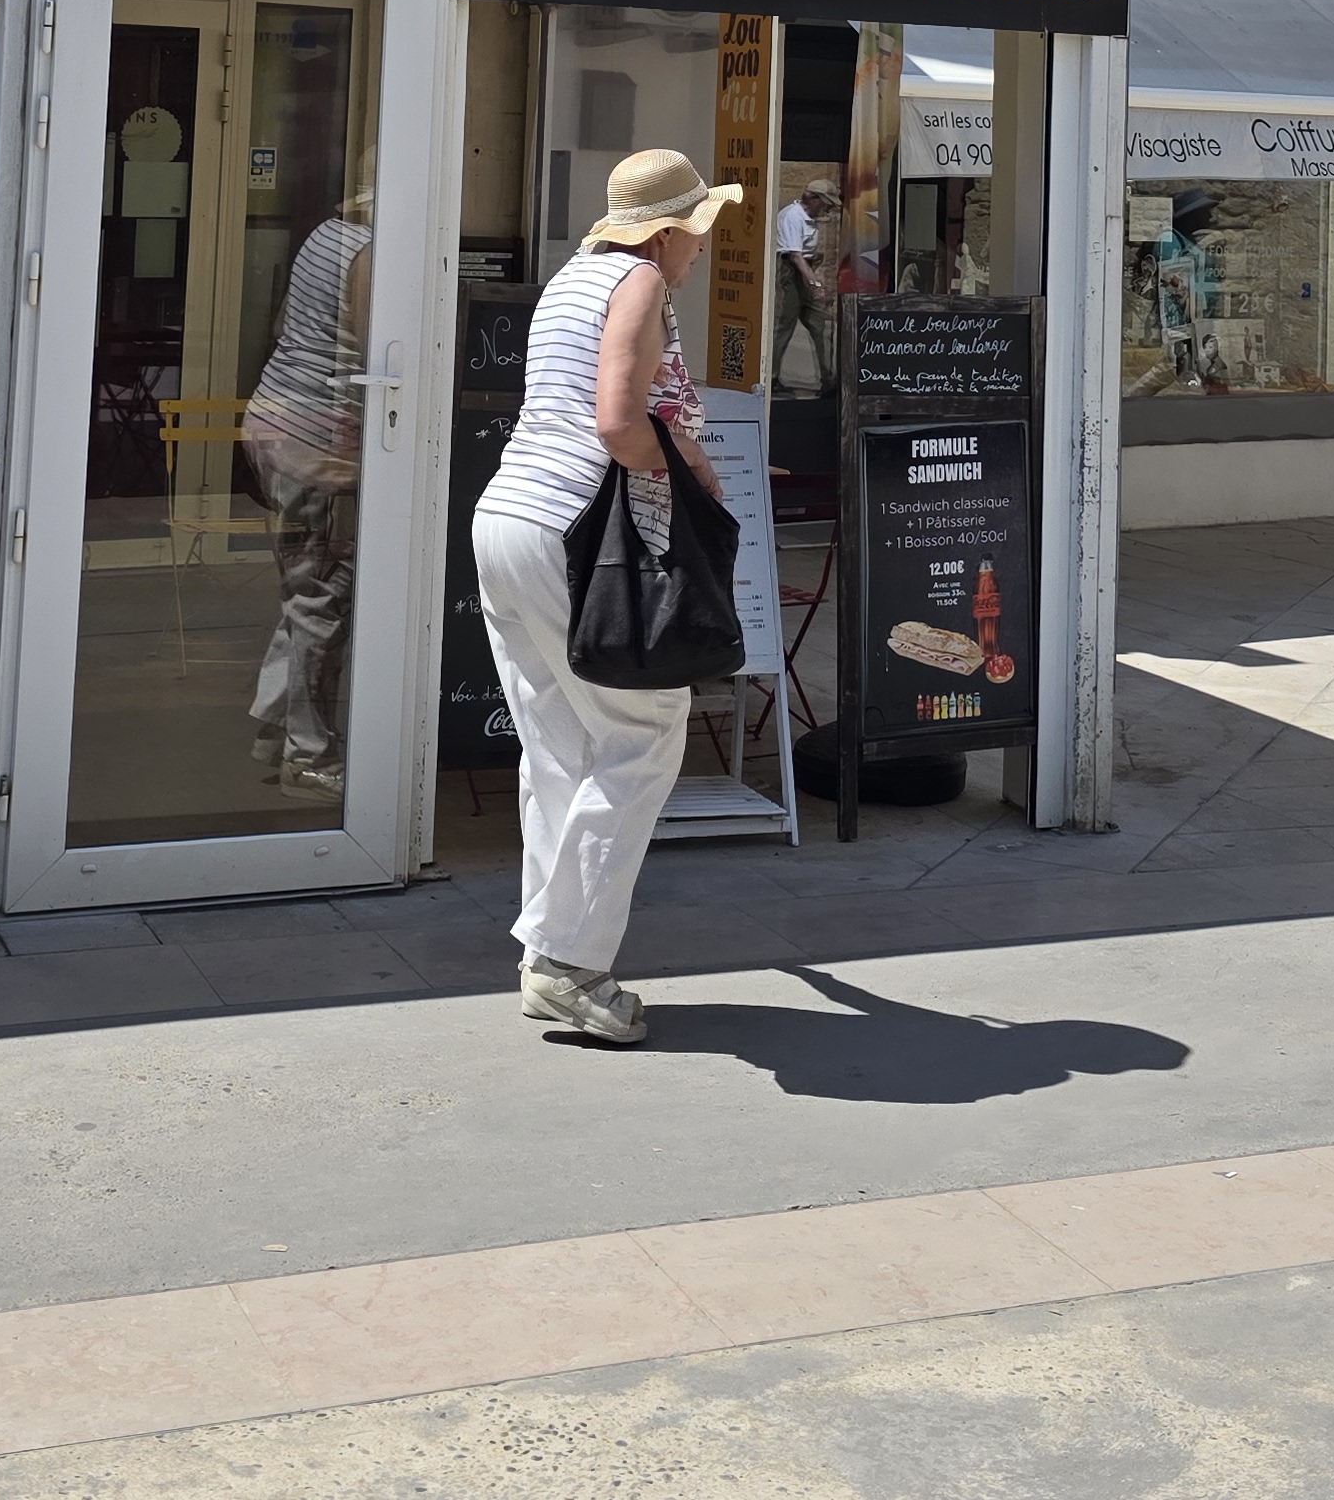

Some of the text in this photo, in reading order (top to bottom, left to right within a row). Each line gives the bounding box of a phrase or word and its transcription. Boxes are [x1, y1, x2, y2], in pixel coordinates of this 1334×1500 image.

[924, 111, 993, 129] sarl les co
[727, 137, 754, 159] LE PAIN
[936, 143, 993, 166] 04 90
[1126, 132, 1222, 163] Visagiste
[470, 316, 523, 369] Nos
[929, 339, 945, 355] de
[894, 366, 911, 382] du
[916, 369, 947, 389] pain
[950, 366, 963, 382] de
[971, 367, 1023, 383] tradition
[911, 436, 978, 458] FORMULE
[907, 461, 982, 484] SANDWICH
[881, 496, 1010, 515] 1 Sandwich classique
[907, 514, 986, 529] + 1 Pâtisserie
[885, 529, 1007, 548] + 1 Boisson 40/50cl
[929, 560, 965, 576] 12.00€
